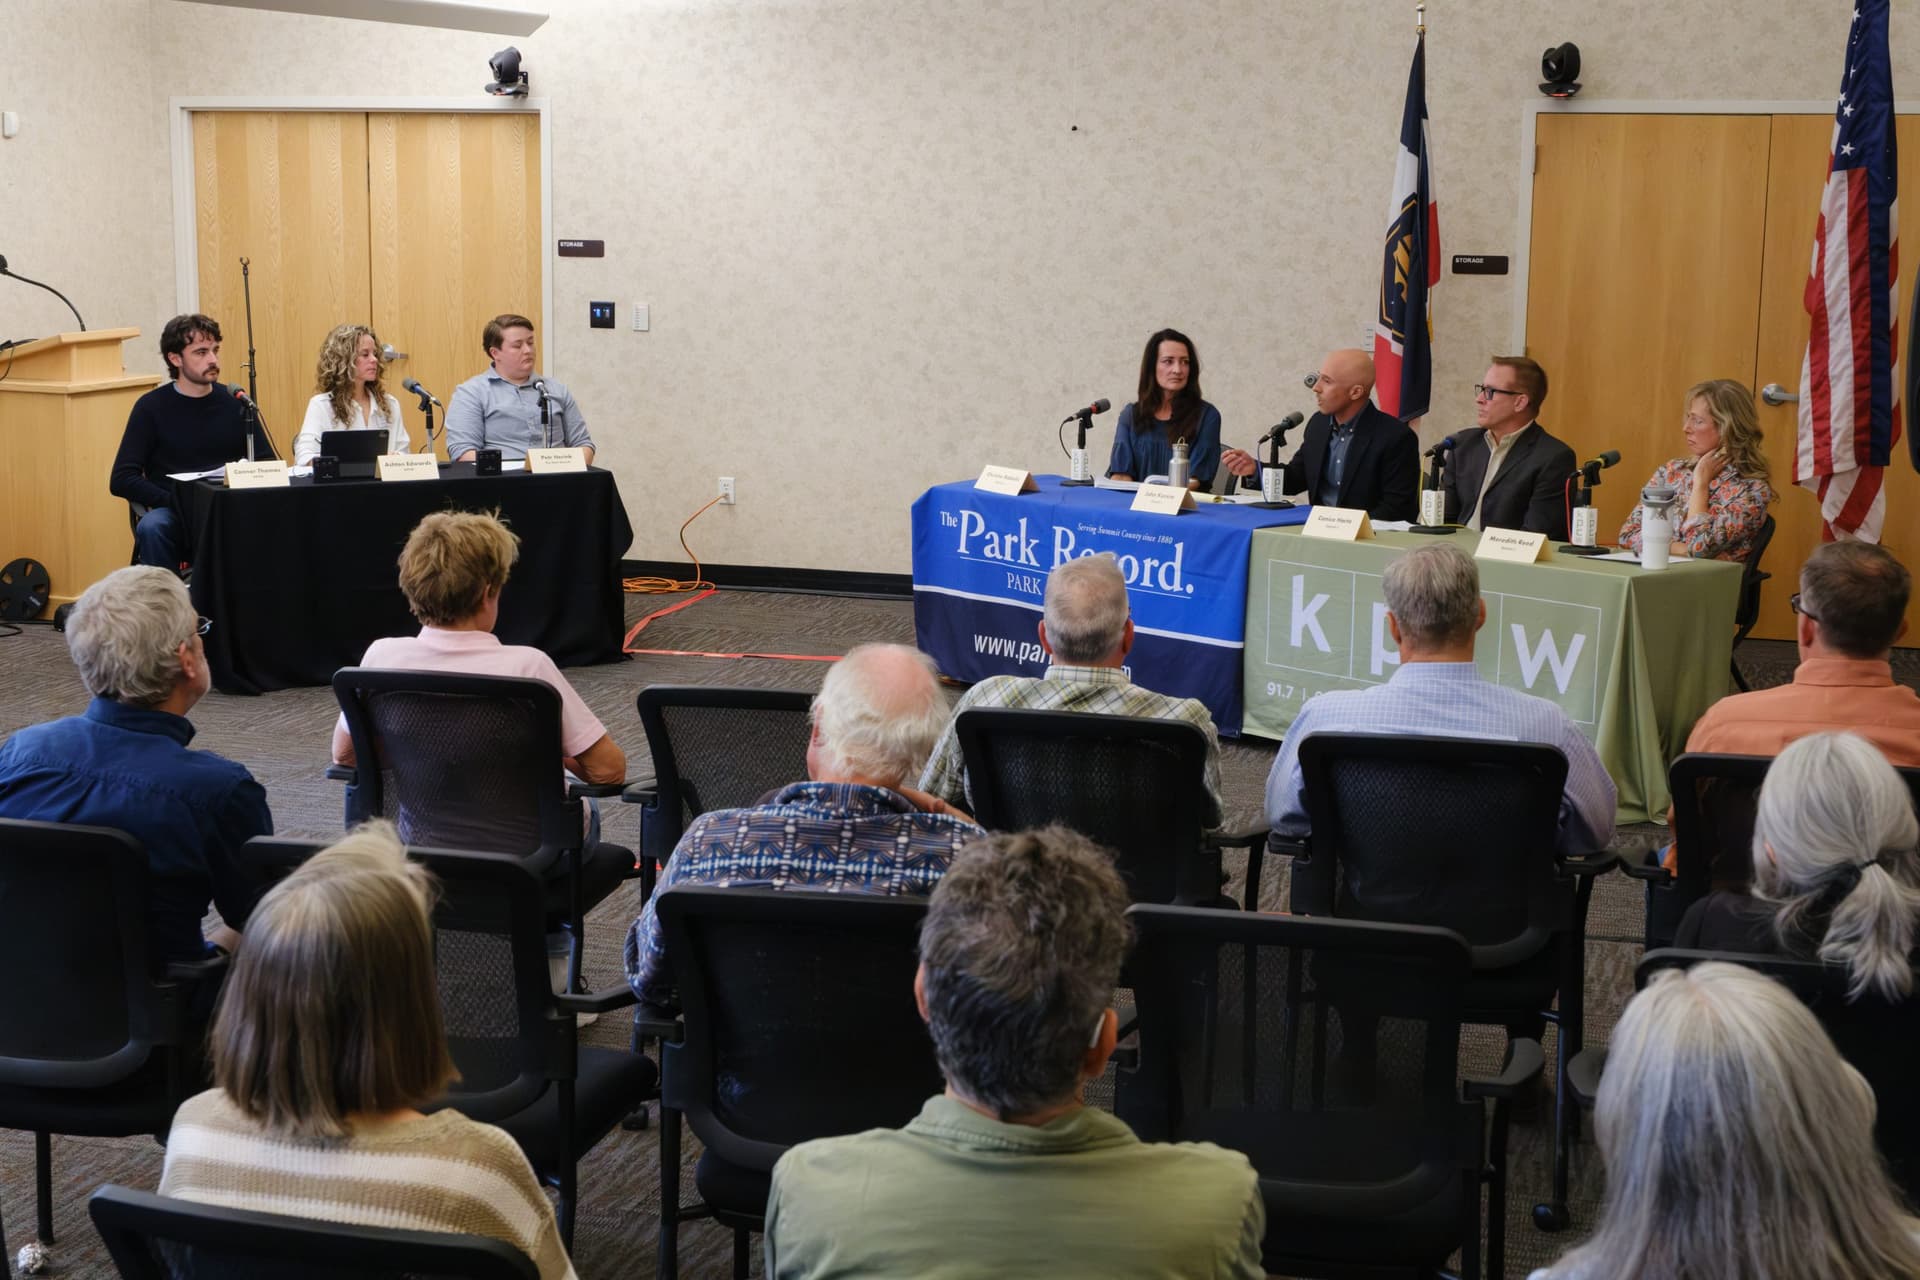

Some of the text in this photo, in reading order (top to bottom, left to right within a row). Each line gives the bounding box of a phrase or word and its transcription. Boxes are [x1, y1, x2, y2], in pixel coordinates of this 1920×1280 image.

[940, 511, 958, 528] The
[956, 509, 1041, 568] Park
[1077, 522, 1097, 535] Serving
[1097, 525, 1121, 537] Summit
[1121, 529, 1142, 542] County
[1006, 572, 1042, 596] PARK
[1267, 681, 1295, 699] 91.7
